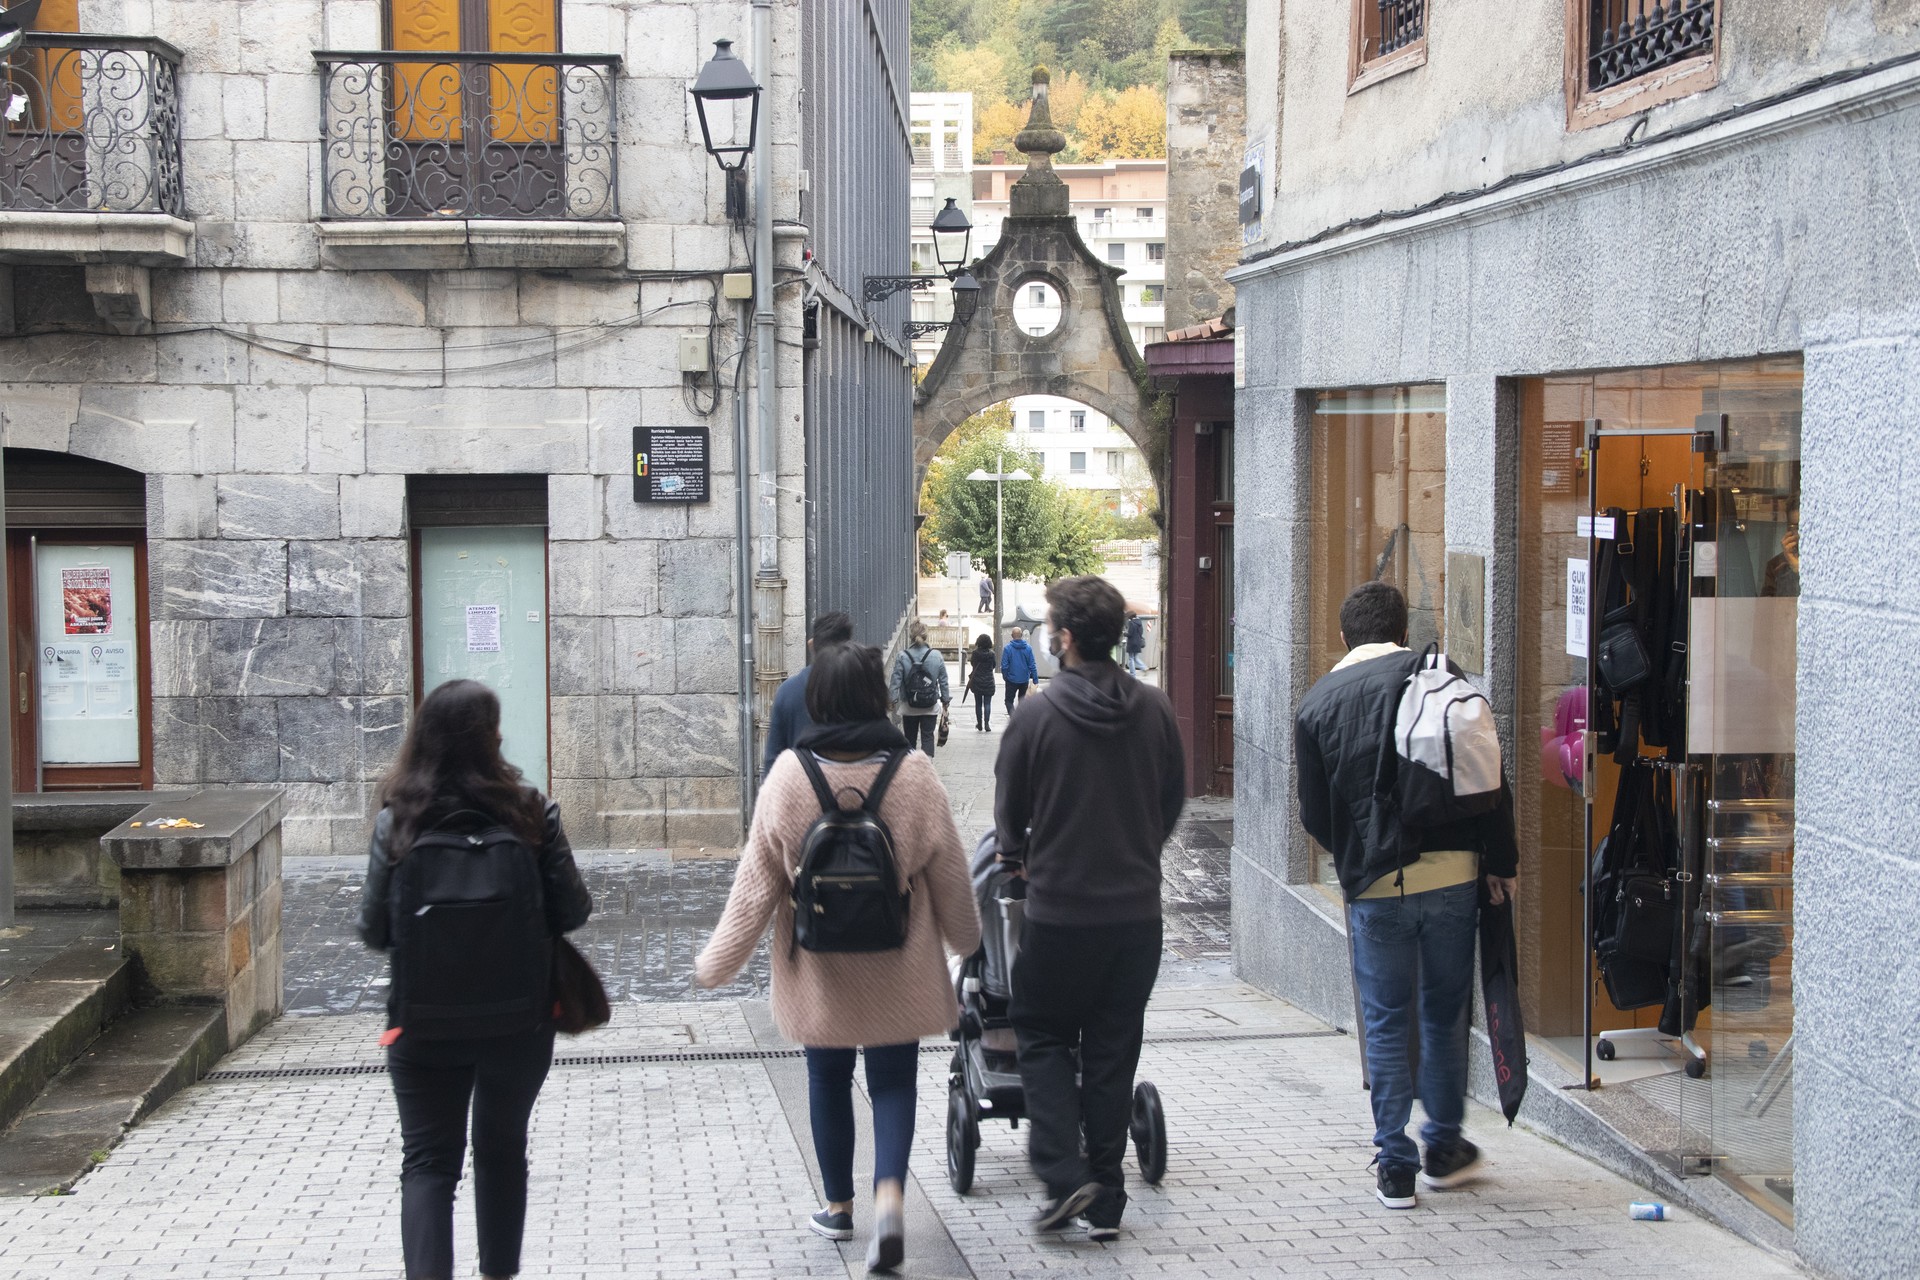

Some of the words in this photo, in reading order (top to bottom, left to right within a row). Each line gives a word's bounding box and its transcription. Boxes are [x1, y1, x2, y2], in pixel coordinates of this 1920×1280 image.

[1572, 570, 1585, 584] GUK
[1572, 585, 1585, 595] EMAN
[1572, 595, 1585, 605] DOGU
[1572, 606, 1585, 616] IZENA
